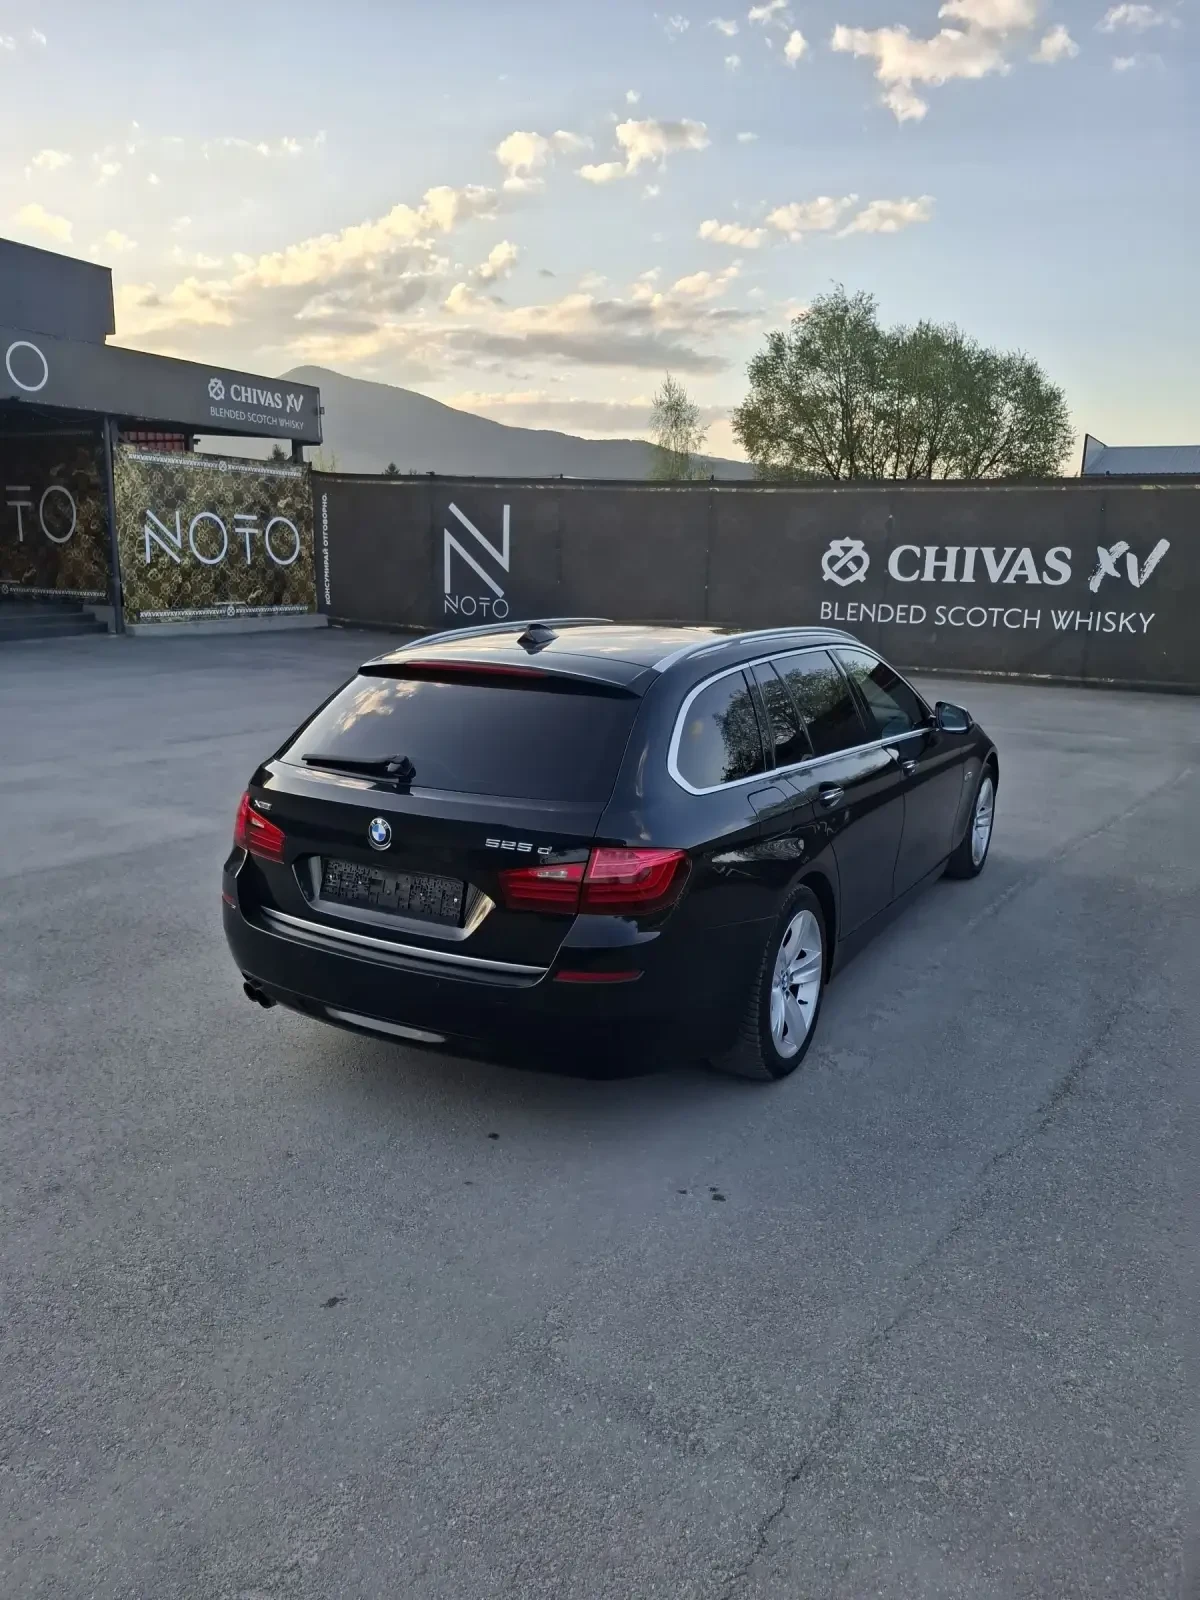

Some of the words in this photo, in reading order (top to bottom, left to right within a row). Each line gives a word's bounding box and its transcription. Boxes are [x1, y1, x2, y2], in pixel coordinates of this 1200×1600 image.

[230, 384, 282, 409] CHIVAS
[286, 393, 304, 413] XV
[210, 406, 246, 421] BLENDED
[247, 412, 278, 426] SCOTCH
[278, 418, 304, 430] WHISKY
[144, 509, 300, 565] NOTO
[443, 501, 511, 597] N
[323, 548, 331, 605] КОНСУМИРАЙ
[888, 544, 1072, 586] CHIVAS
[1087, 538, 1171, 593] XV
[444, 594, 510, 619] NOTO
[820, 601, 927, 625] BLENDED
[934, 605, 1041, 629] SCOTCH
[1051, 609, 1156, 634] WHISKY
[484, 838, 534, 853] 525
